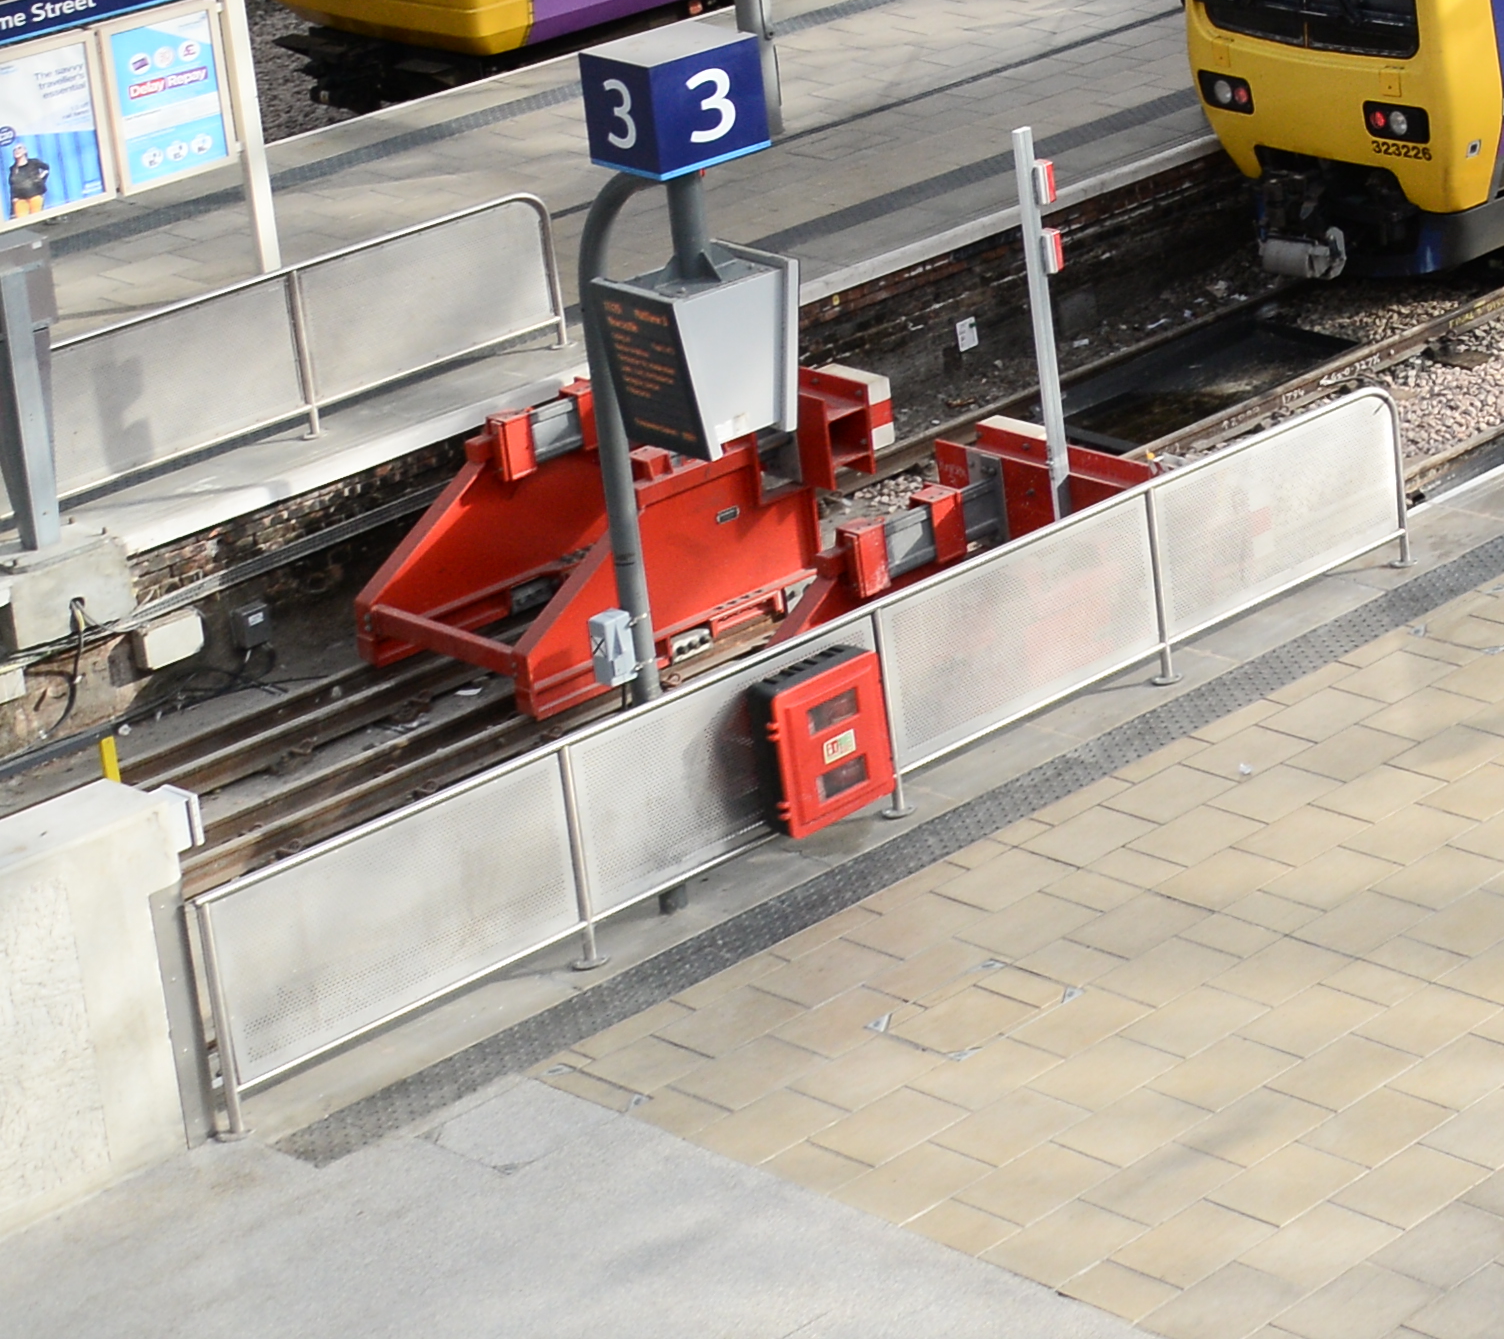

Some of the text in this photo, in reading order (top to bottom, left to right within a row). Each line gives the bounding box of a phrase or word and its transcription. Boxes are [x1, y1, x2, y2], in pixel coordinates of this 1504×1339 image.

[0, 13, 26, 31] me
[129, 68, 206, 98] Delay Repay
[603, 78, 637, 150] 3
[685, 68, 736, 143] 3
[1371, 139, 1432, 162] 323226
